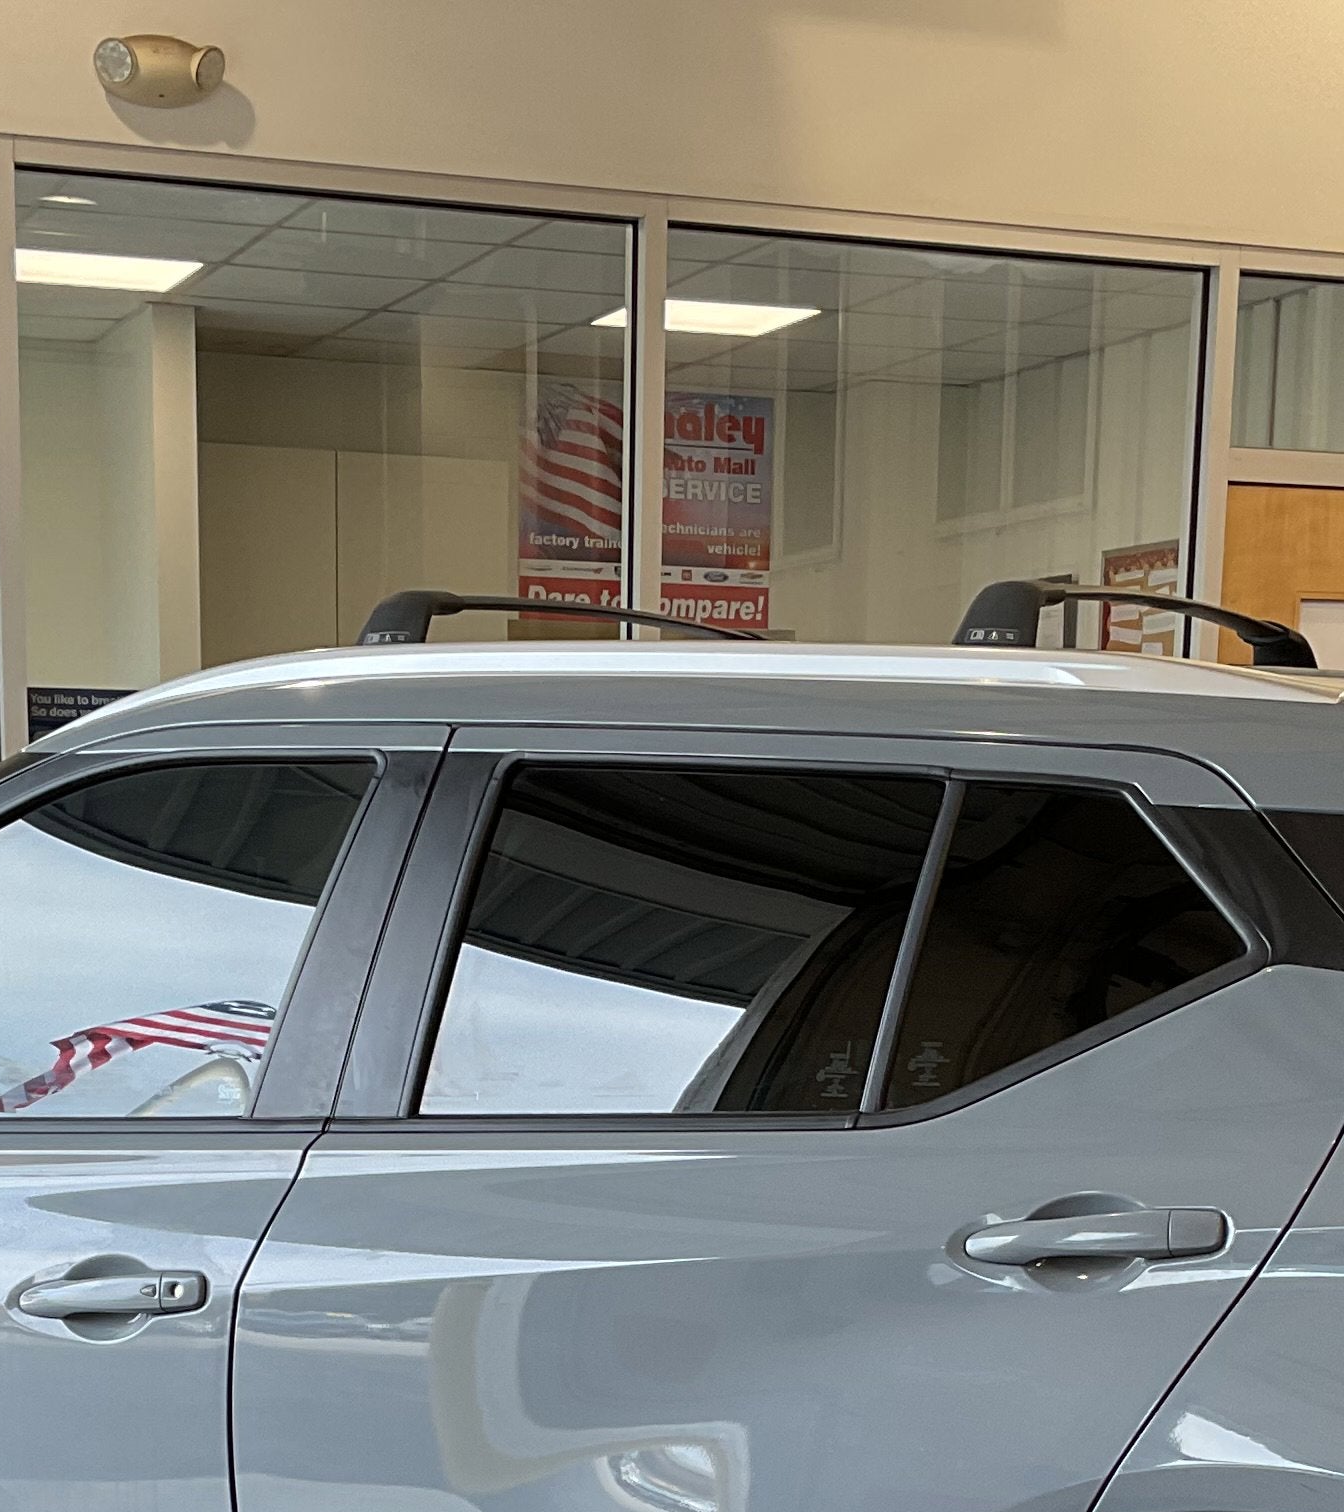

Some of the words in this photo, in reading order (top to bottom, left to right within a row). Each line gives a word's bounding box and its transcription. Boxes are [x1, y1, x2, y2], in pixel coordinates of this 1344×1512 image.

[713, 456, 756, 476] Mall
[529, 532, 580, 549] factory
[739, 527, 761, 538] are
[707, 543, 761, 557] vehicle!
[31, 693, 51, 704] You
[54, 694, 75, 705] like
[77, 695, 89, 705] to
[31, 706, 47, 716] So
[50, 706, 77, 717] does
